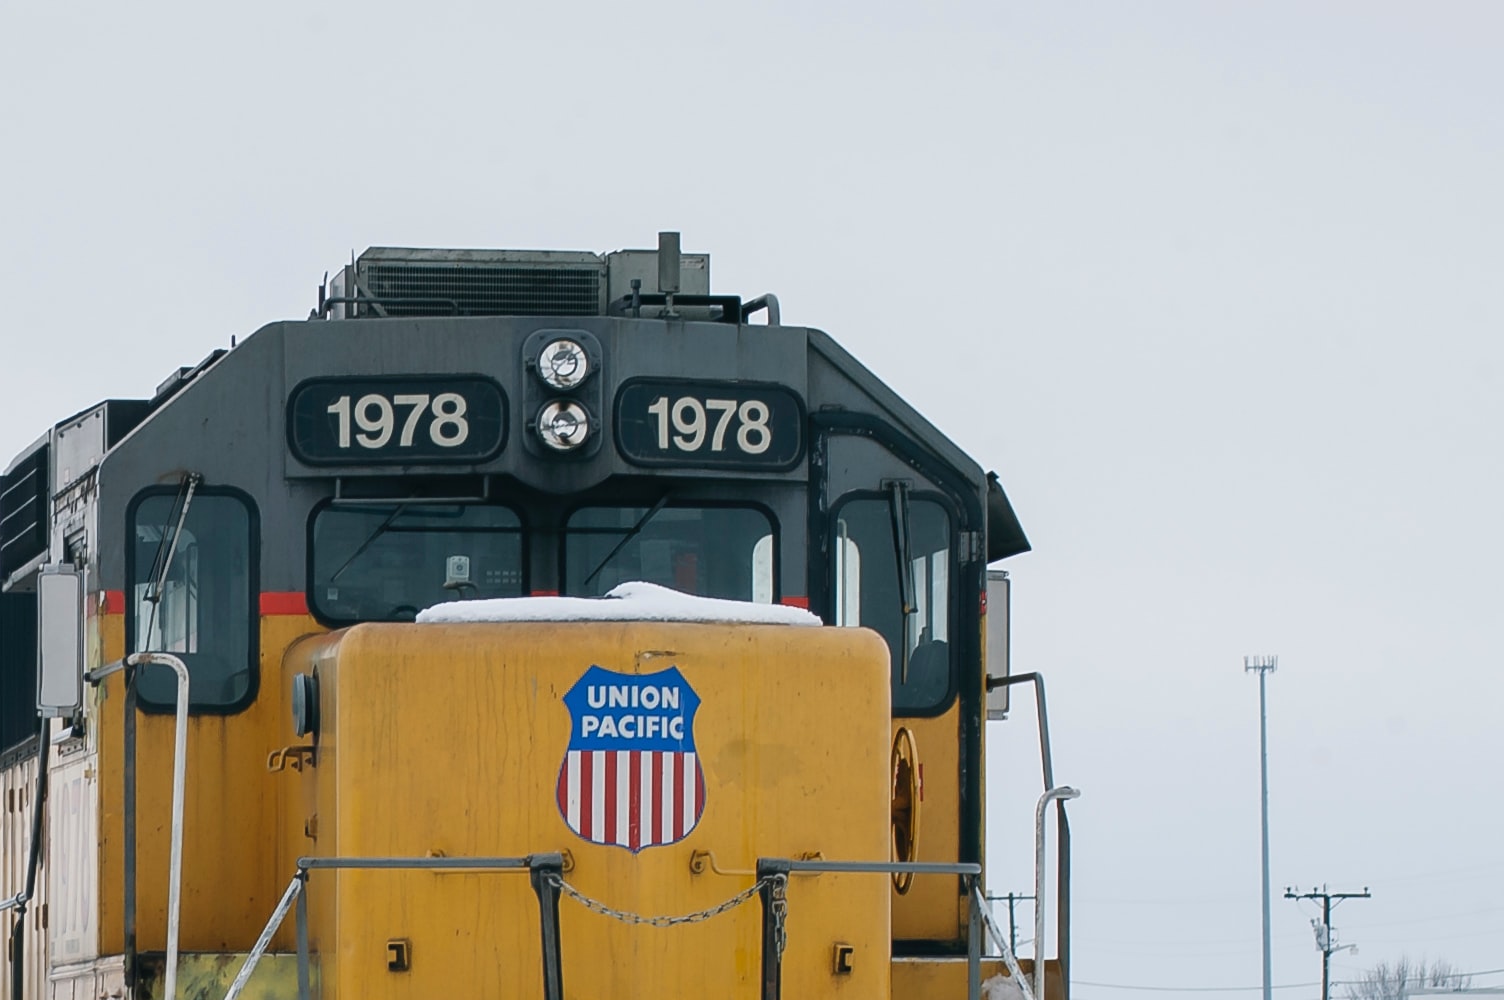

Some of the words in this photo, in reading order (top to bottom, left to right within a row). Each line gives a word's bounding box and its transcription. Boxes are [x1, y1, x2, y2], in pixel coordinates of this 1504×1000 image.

[327, 392, 469, 449] 1978
[647, 396, 771, 454] 1978
[587, 685, 679, 709] UNION
[581, 715, 684, 739] PACIFIC
